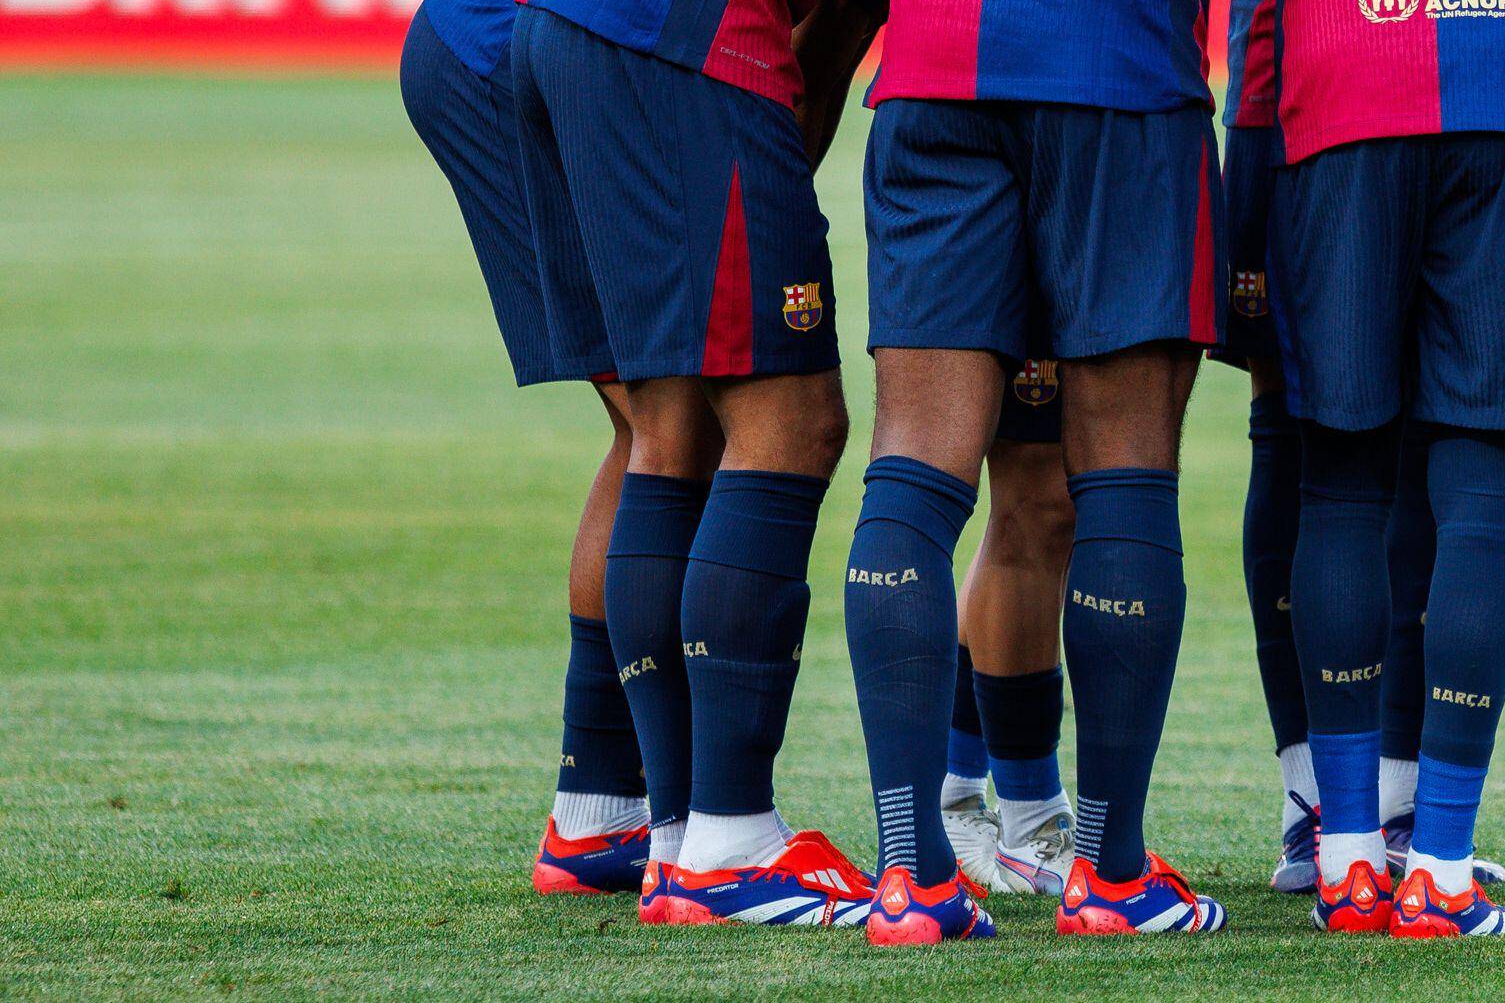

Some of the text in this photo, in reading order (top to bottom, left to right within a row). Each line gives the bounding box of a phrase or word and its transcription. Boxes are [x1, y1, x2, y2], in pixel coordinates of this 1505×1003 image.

[1441, 10, 1454, 18] UN
[1455, 10, 1487, 18] Refugee
[848, 567, 919, 587] BARÇA
[1072, 589, 1145, 617] BARÇA
[618, 656, 657, 686] ARÇA
[1321, 662, 1382, 684] BARÇA
[1432, 686, 1491, 709] BARÇA
[706, 882, 740, 895] PREDATOR
